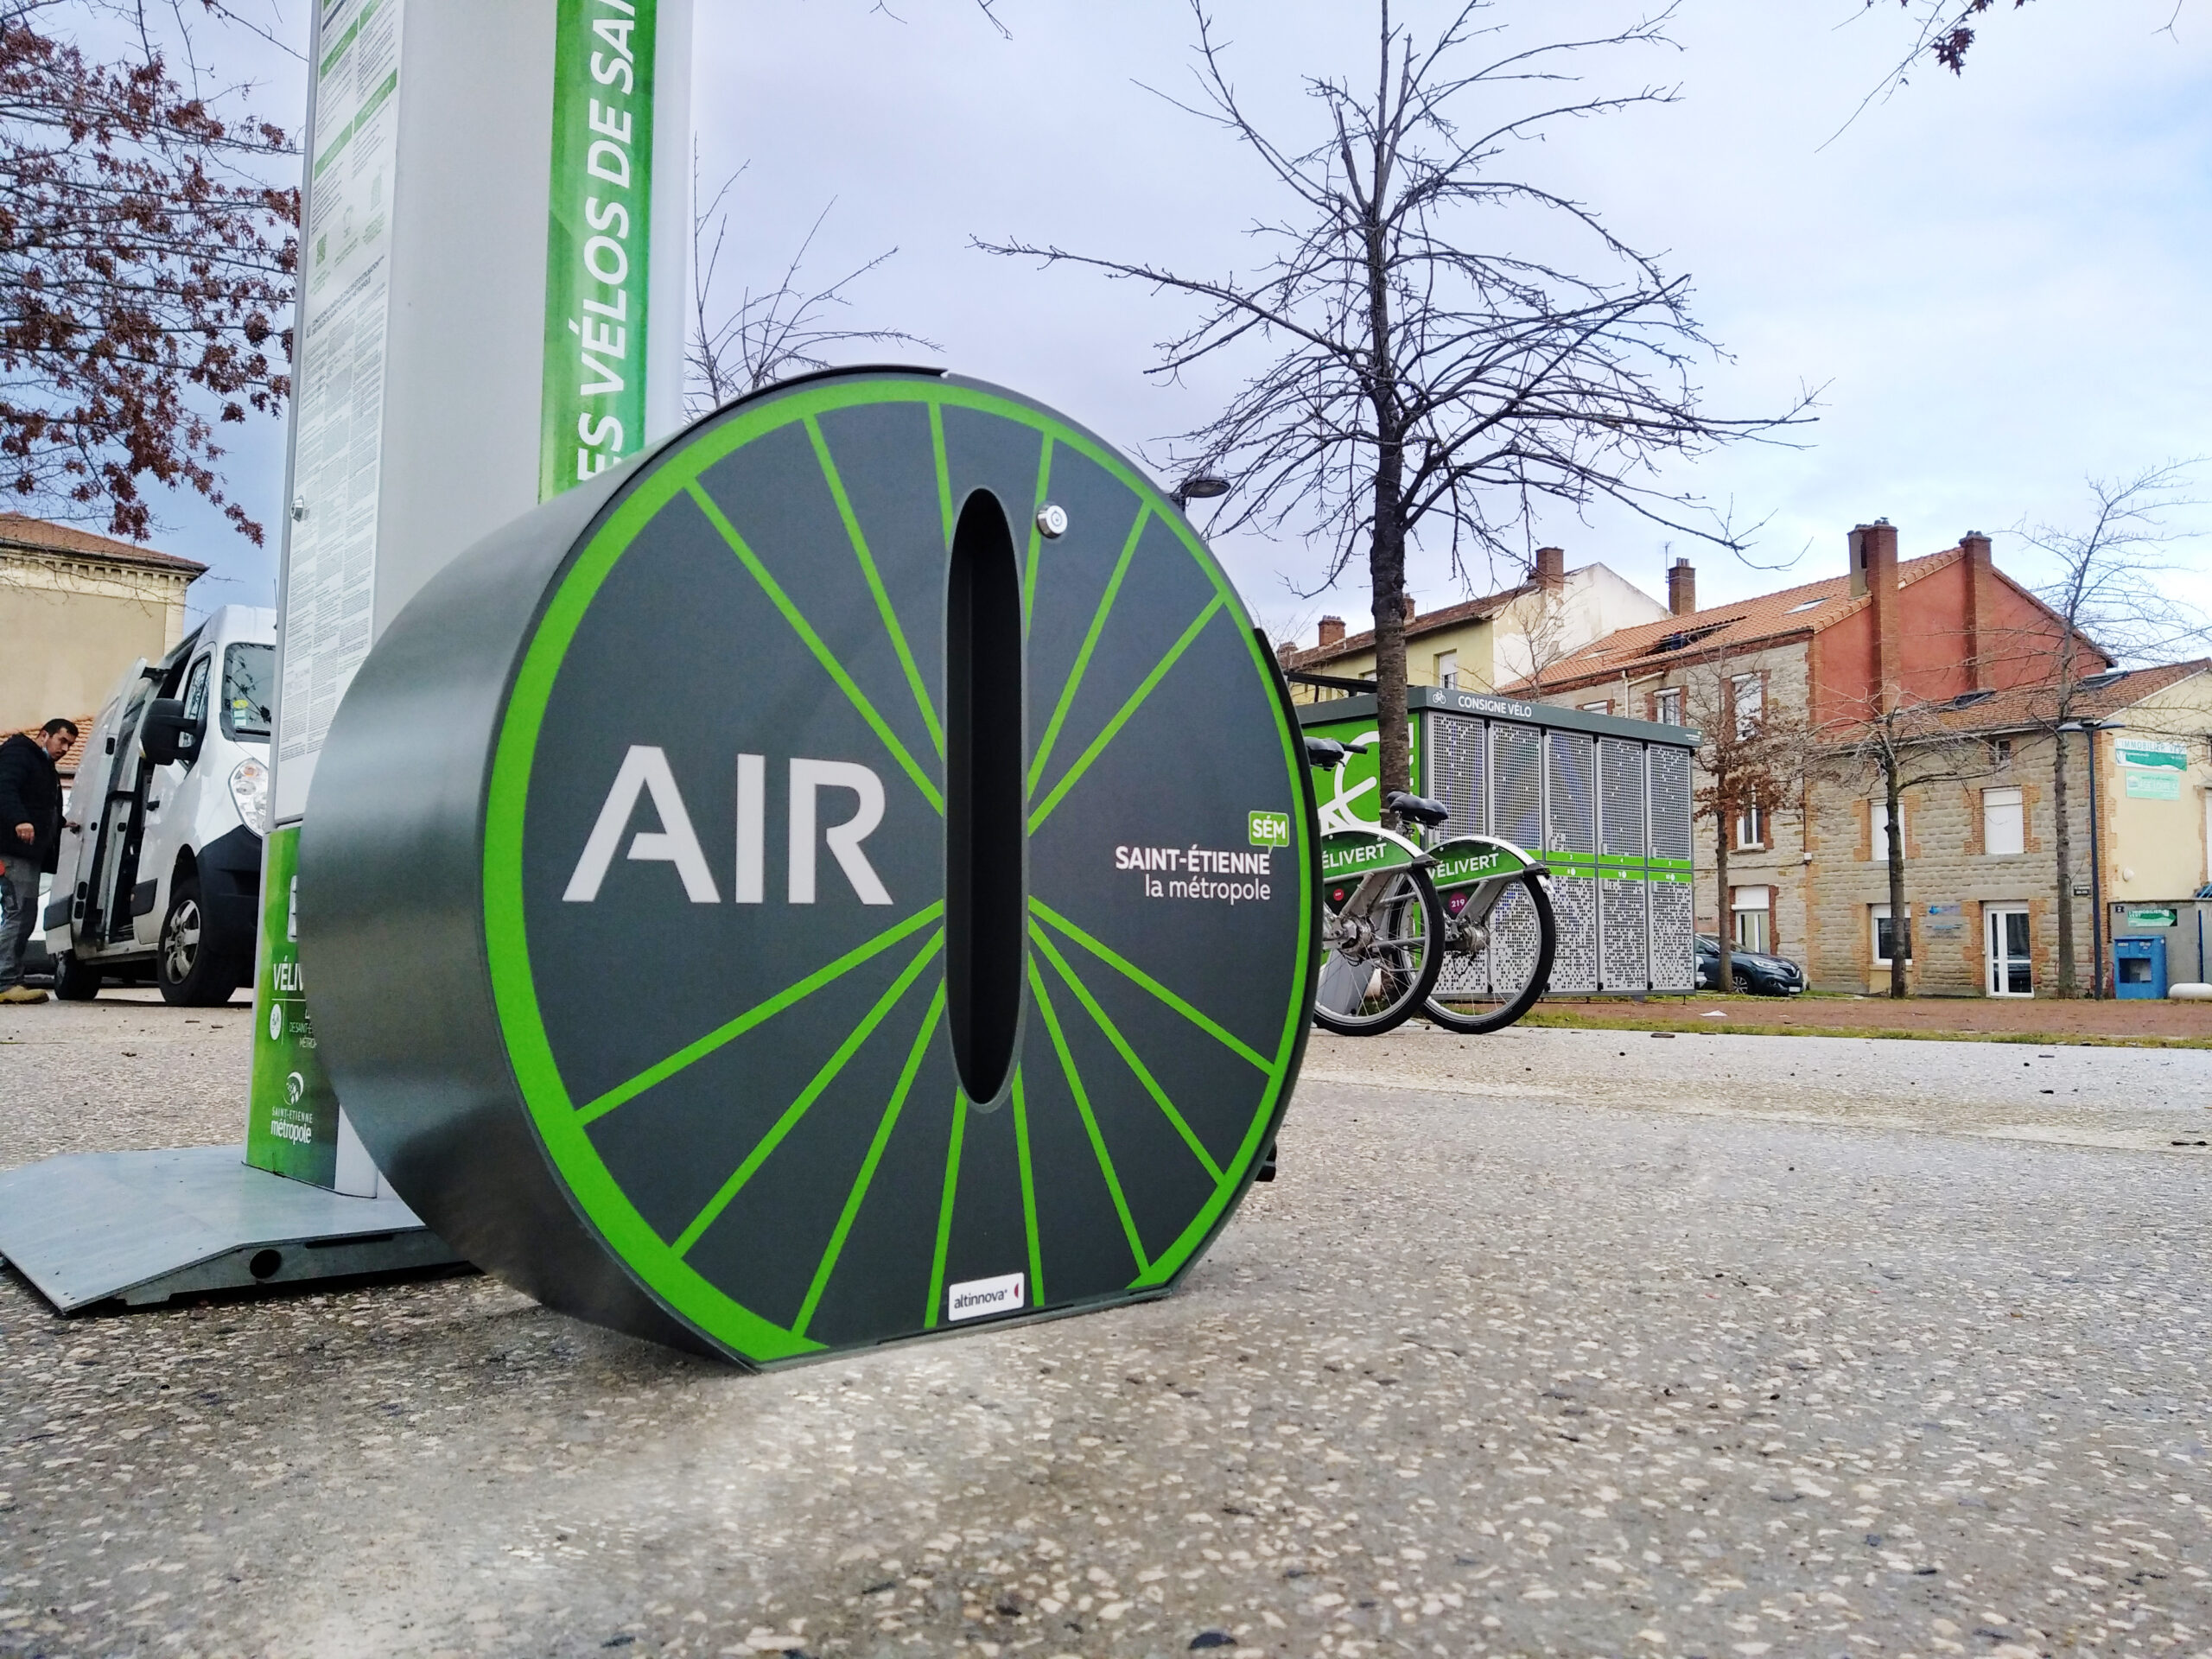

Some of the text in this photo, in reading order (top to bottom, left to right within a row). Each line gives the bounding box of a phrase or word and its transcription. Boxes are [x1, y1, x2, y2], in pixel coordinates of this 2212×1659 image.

[587, 98, 632, 188] DE
[569, 196, 629, 396] VÉLOS
[1458, 695, 1532, 718] CONSIGNE VÉLO
[563, 745, 893, 905] AIR
[1252, 815, 1286, 840] SÉM
[1116, 844, 1271, 875] SAINT-ÉTIENNE
[1427, 852, 1500, 880] VÉLIVERT
[1145, 874, 1271, 906] la métropole
[1451, 898, 1465, 908] 219
[270, 1118, 312, 1146] métropole
[954, 1288, 1007, 1309] altinnova
